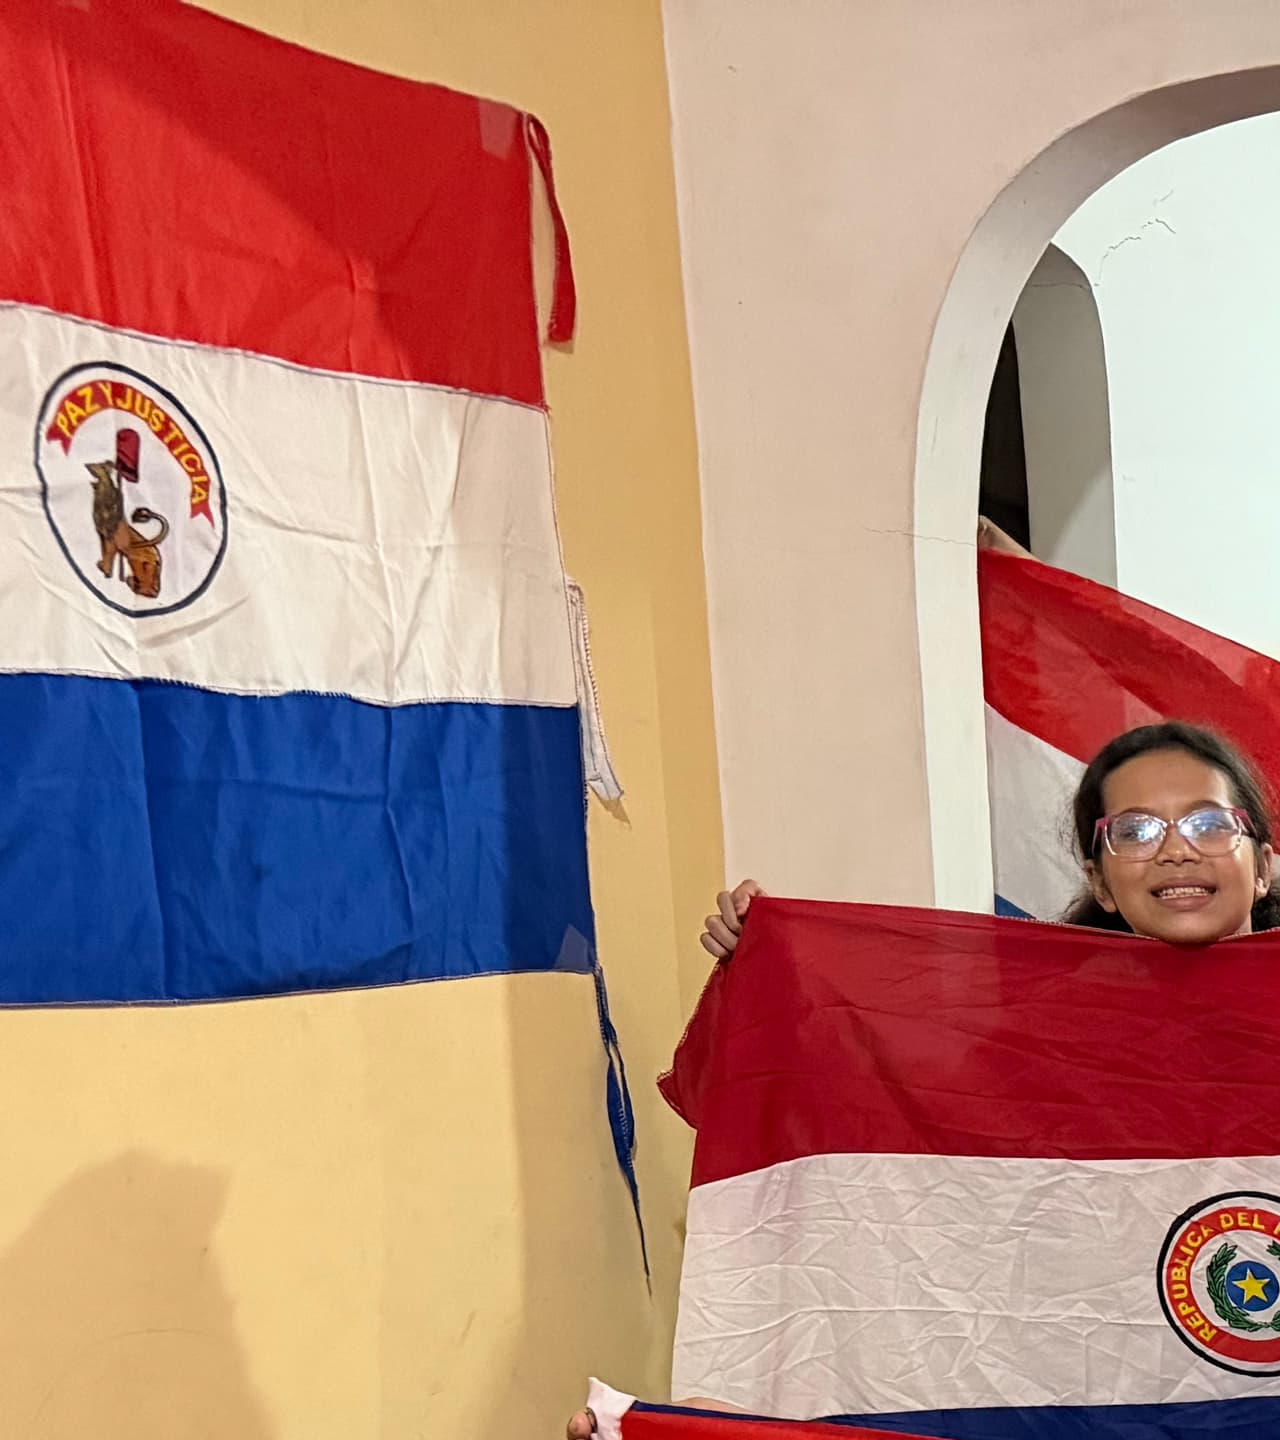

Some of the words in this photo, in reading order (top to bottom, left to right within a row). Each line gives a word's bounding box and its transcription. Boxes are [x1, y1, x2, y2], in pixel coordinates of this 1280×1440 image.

[55, 386, 100, 437] PAZ
[100, 383, 114, 405] Y
[117, 387, 210, 505] JUSTICIA
[1171, 1225, 1218, 1343] REPUBLICA
[1219, 1211, 1266, 1230] DEL
